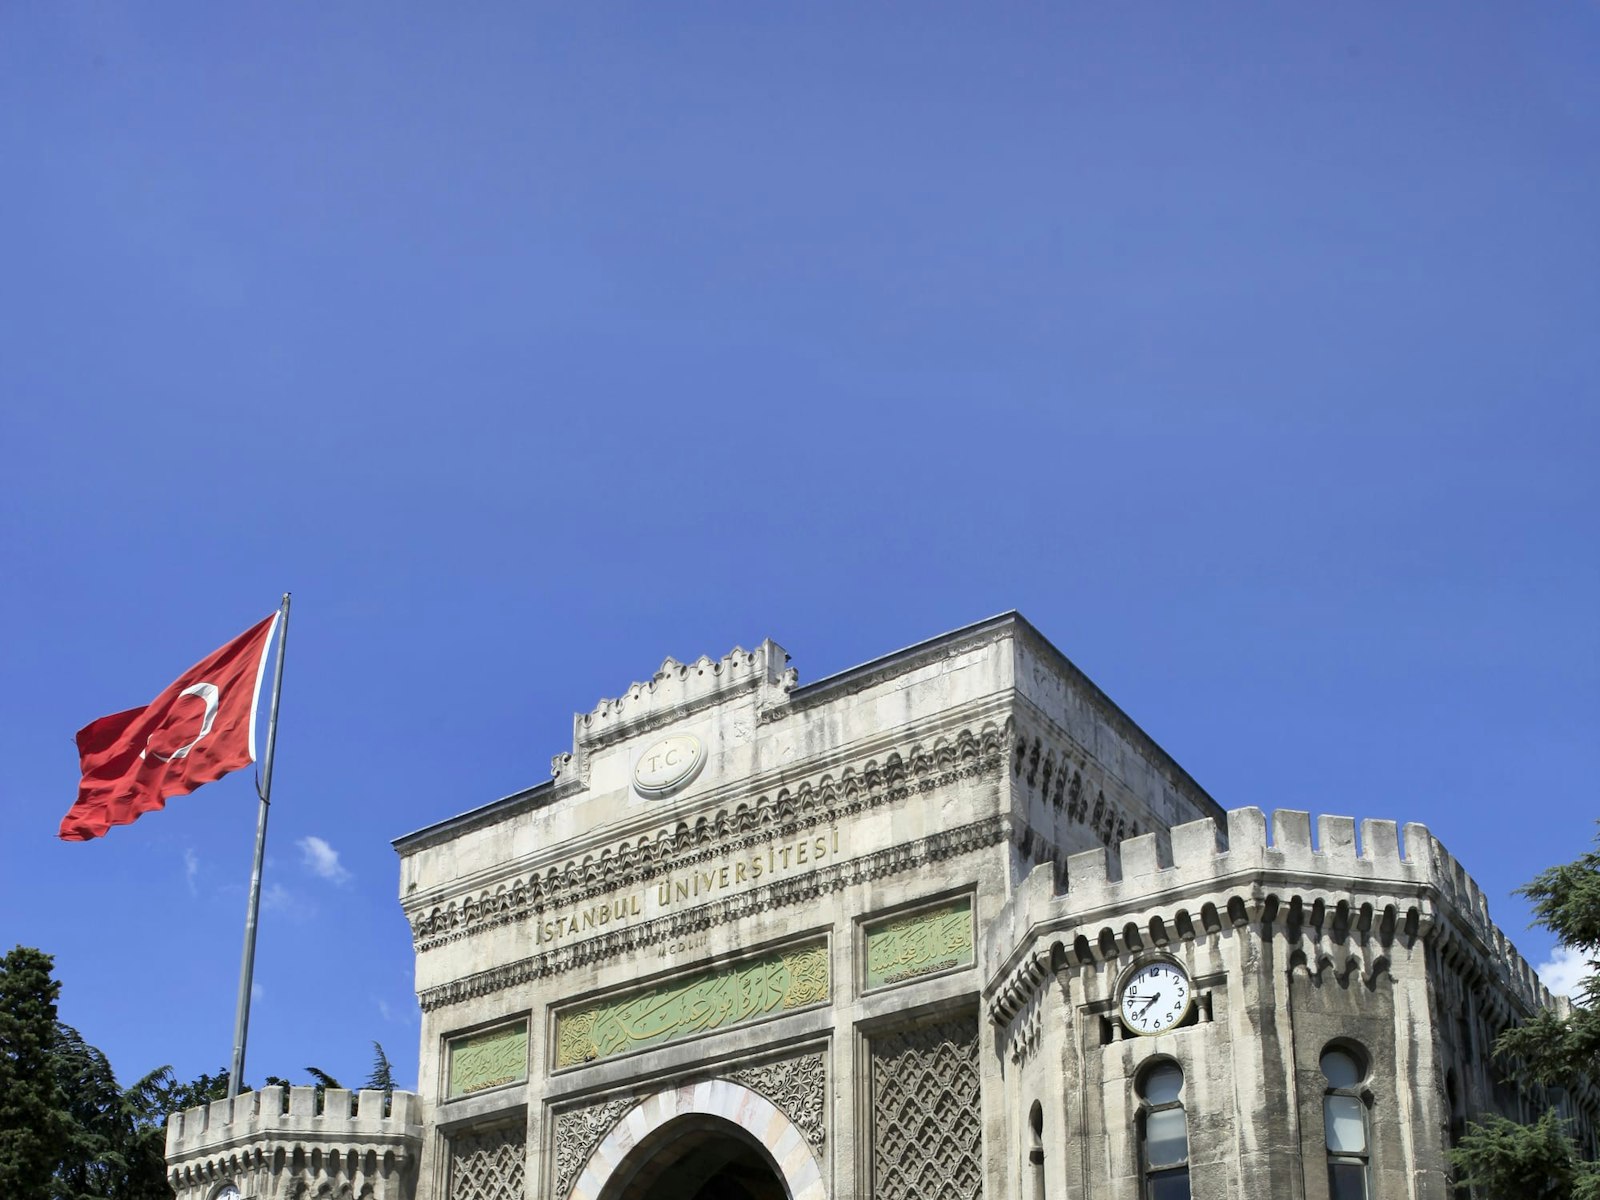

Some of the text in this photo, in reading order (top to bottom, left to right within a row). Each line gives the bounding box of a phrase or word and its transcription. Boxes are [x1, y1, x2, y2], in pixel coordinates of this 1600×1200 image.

[647, 749, 682, 773] T.C.
[535, 826, 840, 945] İSTANBUL ÜNİVERSİTESİ
[1150, 967, 1159, 977] 12
[1165, 968, 1168, 977] 1
[1139, 974, 1145, 984] 11
[1173, 975, 1180, 985] 2
[1129, 986, 1137, 995] 10
[1177, 987, 1184, 997] 3
[1127, 1000, 1134, 1009] 9
[1174, 1001, 1182, 1010] 4
[1132, 1011, 1138, 1020] 8
[1166, 1012, 1173, 1022] 5
[1141, 1018, 1147, 1028] 7
[1154, 1019, 1160, 1028] 6
